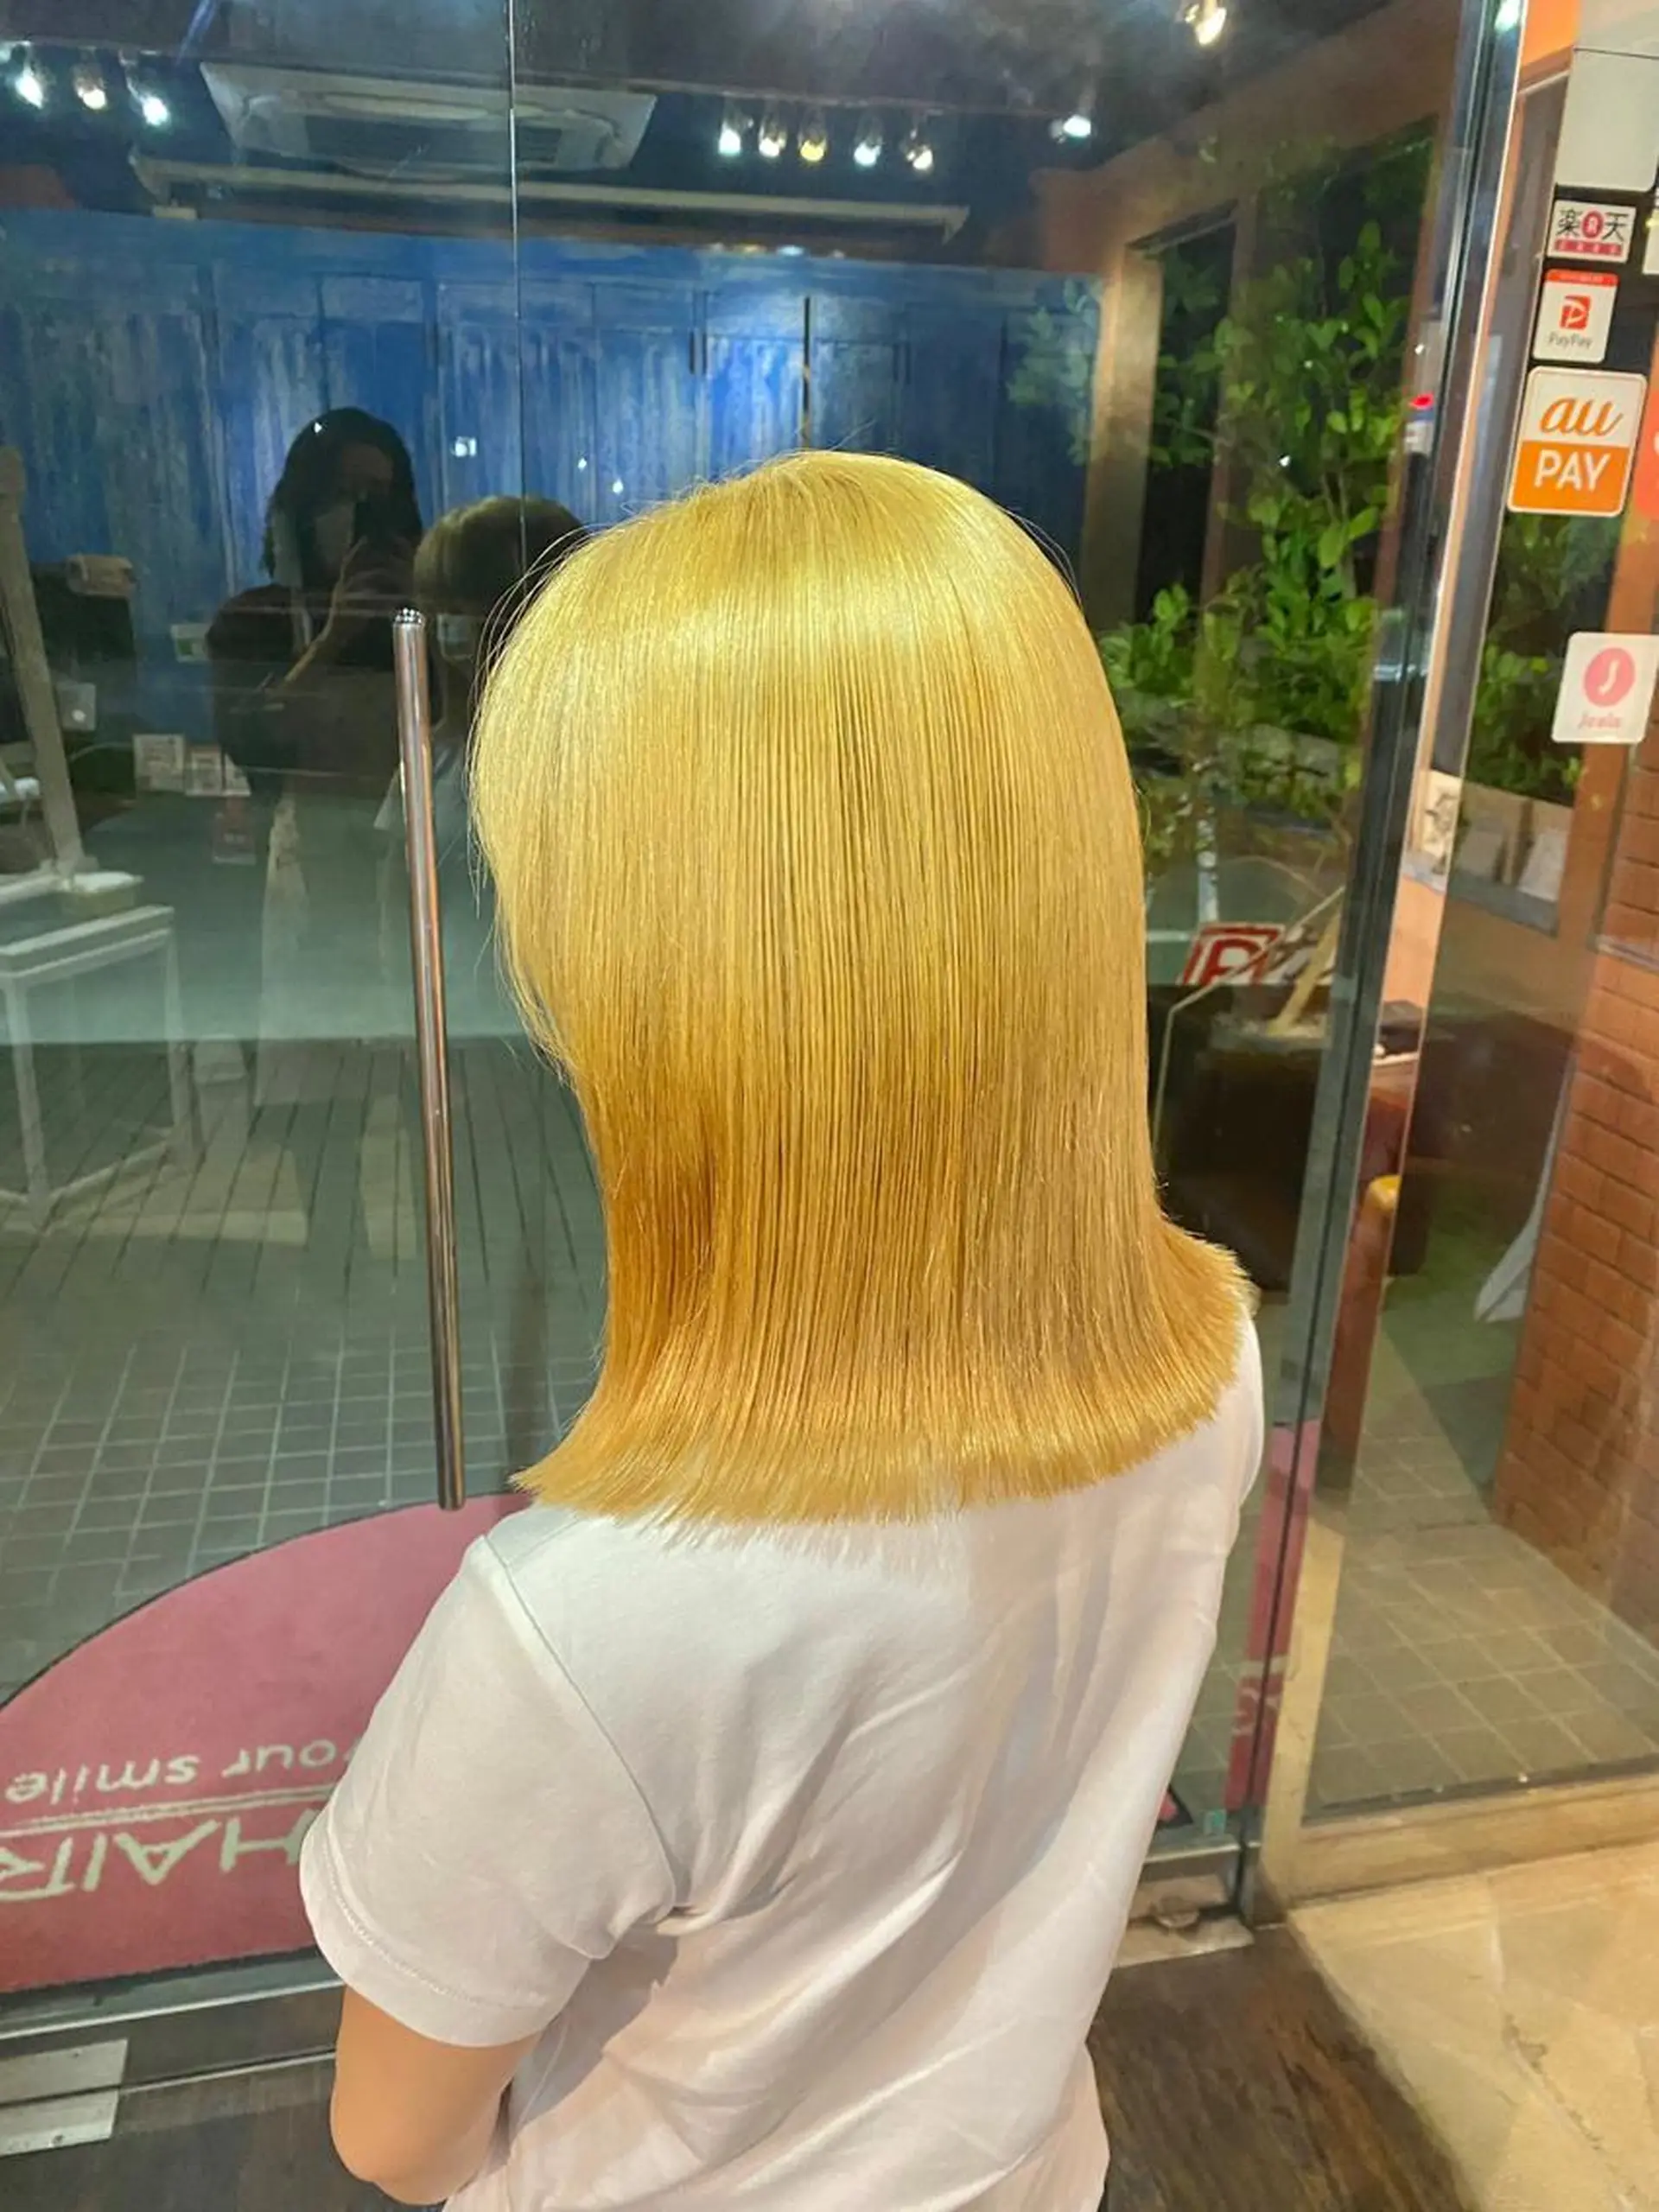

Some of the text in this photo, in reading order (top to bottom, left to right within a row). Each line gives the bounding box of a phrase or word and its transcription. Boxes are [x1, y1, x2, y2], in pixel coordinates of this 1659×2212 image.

[1540, 395, 1623, 436] au
[1535, 448, 1612, 492] PAY
[6, 1738, 358, 1805] our smile
